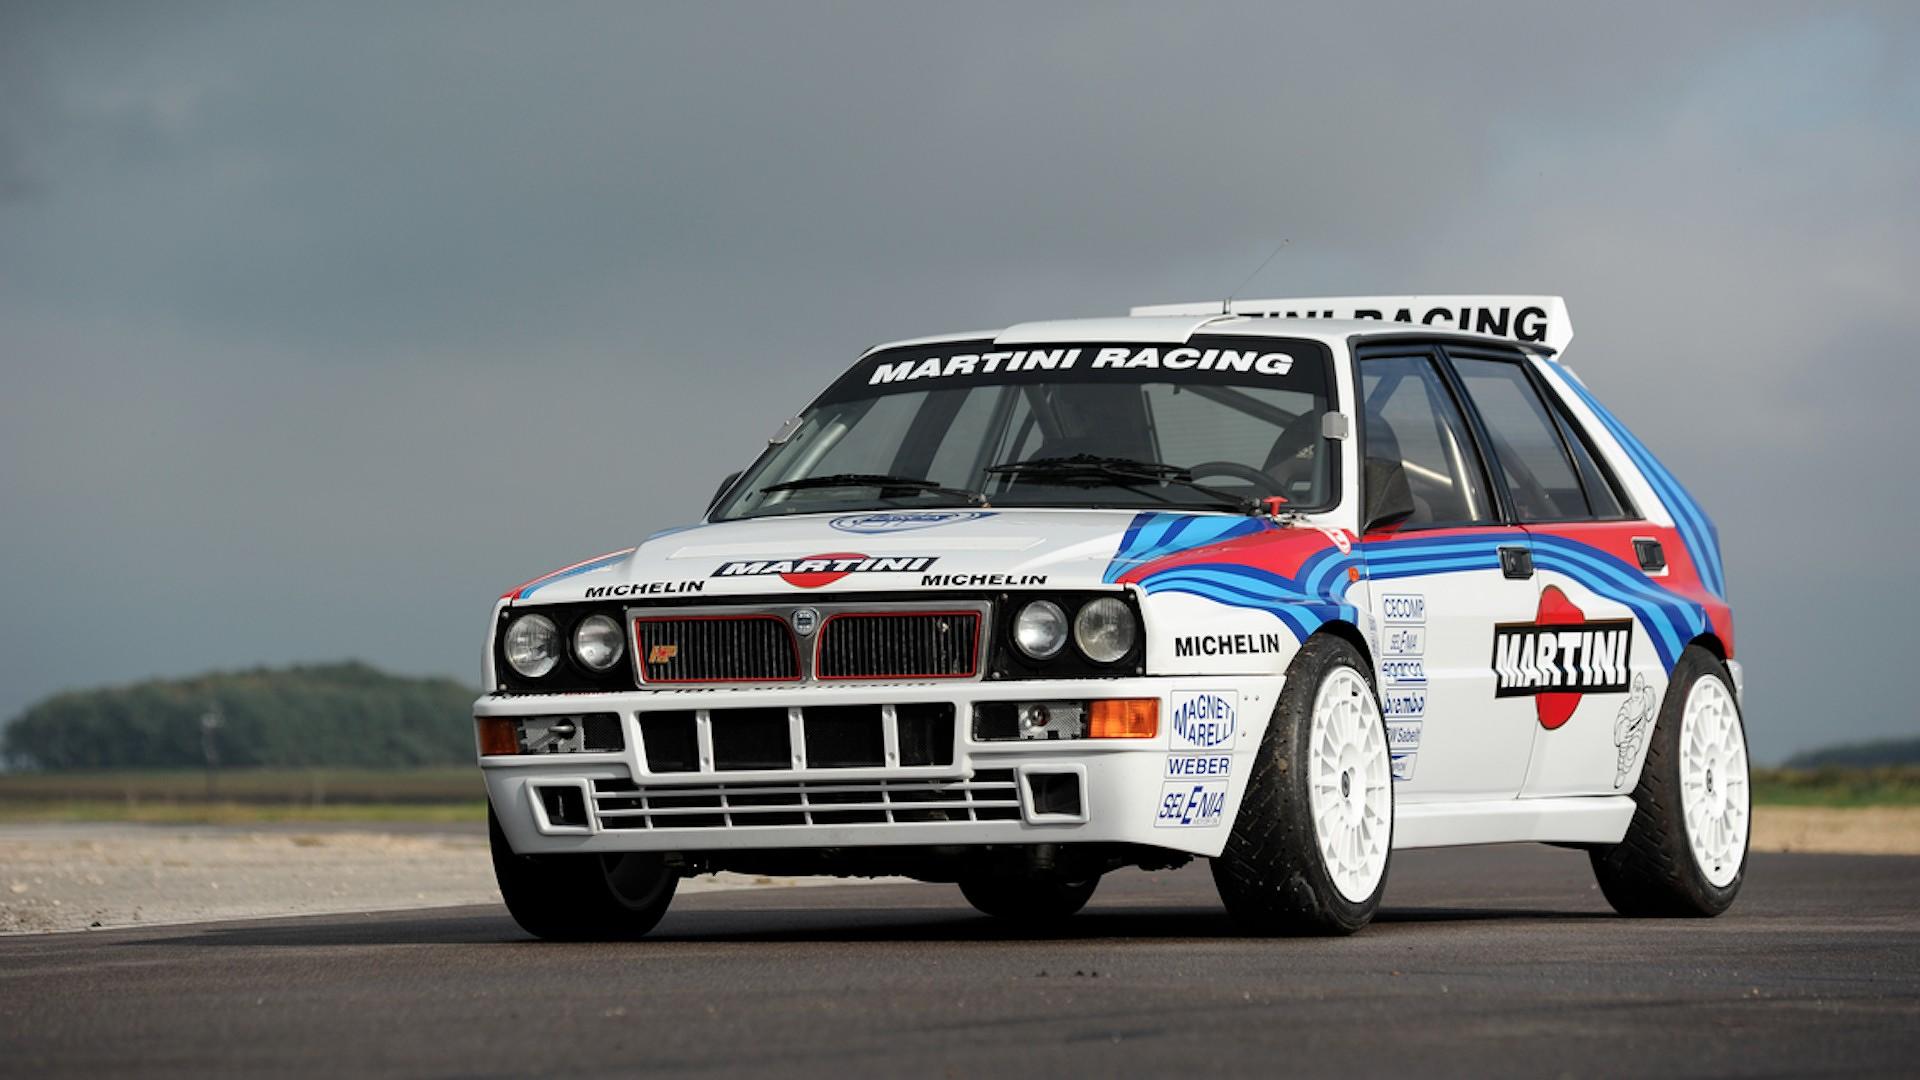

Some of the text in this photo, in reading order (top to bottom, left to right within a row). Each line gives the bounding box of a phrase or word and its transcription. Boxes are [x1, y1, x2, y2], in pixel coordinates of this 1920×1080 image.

[868, 348, 1294, 386] MARTINI RACING
[720, 557, 930, 576] MARTINI
[585, 580, 705, 598] MICHELIN
[921, 574, 1048, 586] MICHELIN
[1384, 599, 1425, 617] CECOMP
[1175, 633, 1280, 657] MICHELIN
[1496, 630, 1628, 688] MARTINI
[1168, 758, 1230, 774] WEBER
[1159, 786, 1225, 824] SELENIA
